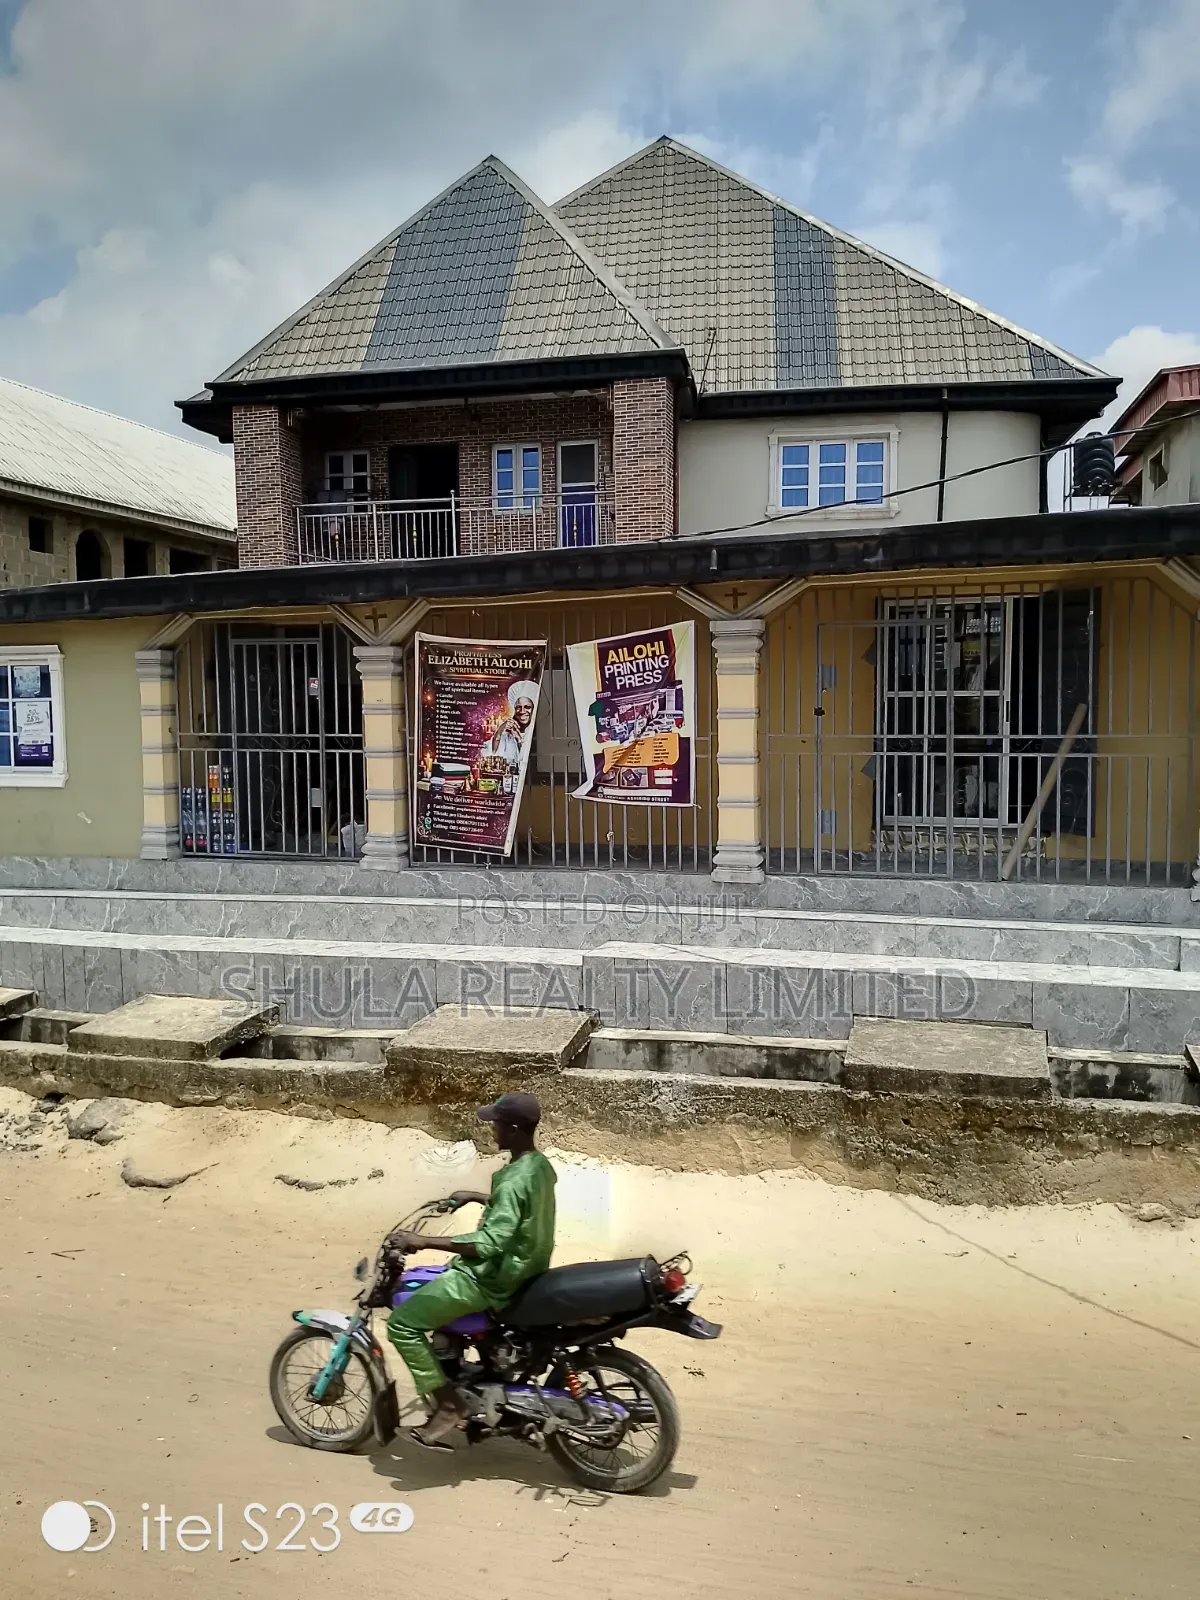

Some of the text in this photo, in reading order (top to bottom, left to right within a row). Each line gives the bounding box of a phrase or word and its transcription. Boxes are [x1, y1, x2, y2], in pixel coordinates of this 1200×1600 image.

[428, 655, 532, 669] ELIZABETH AILOHI
[607, 640, 665, 664] AILOHI
[604, 655, 669, 678] PRINTING
[615, 670, 662, 690] PRESS
[474, 799, 506, 807] worldwide
